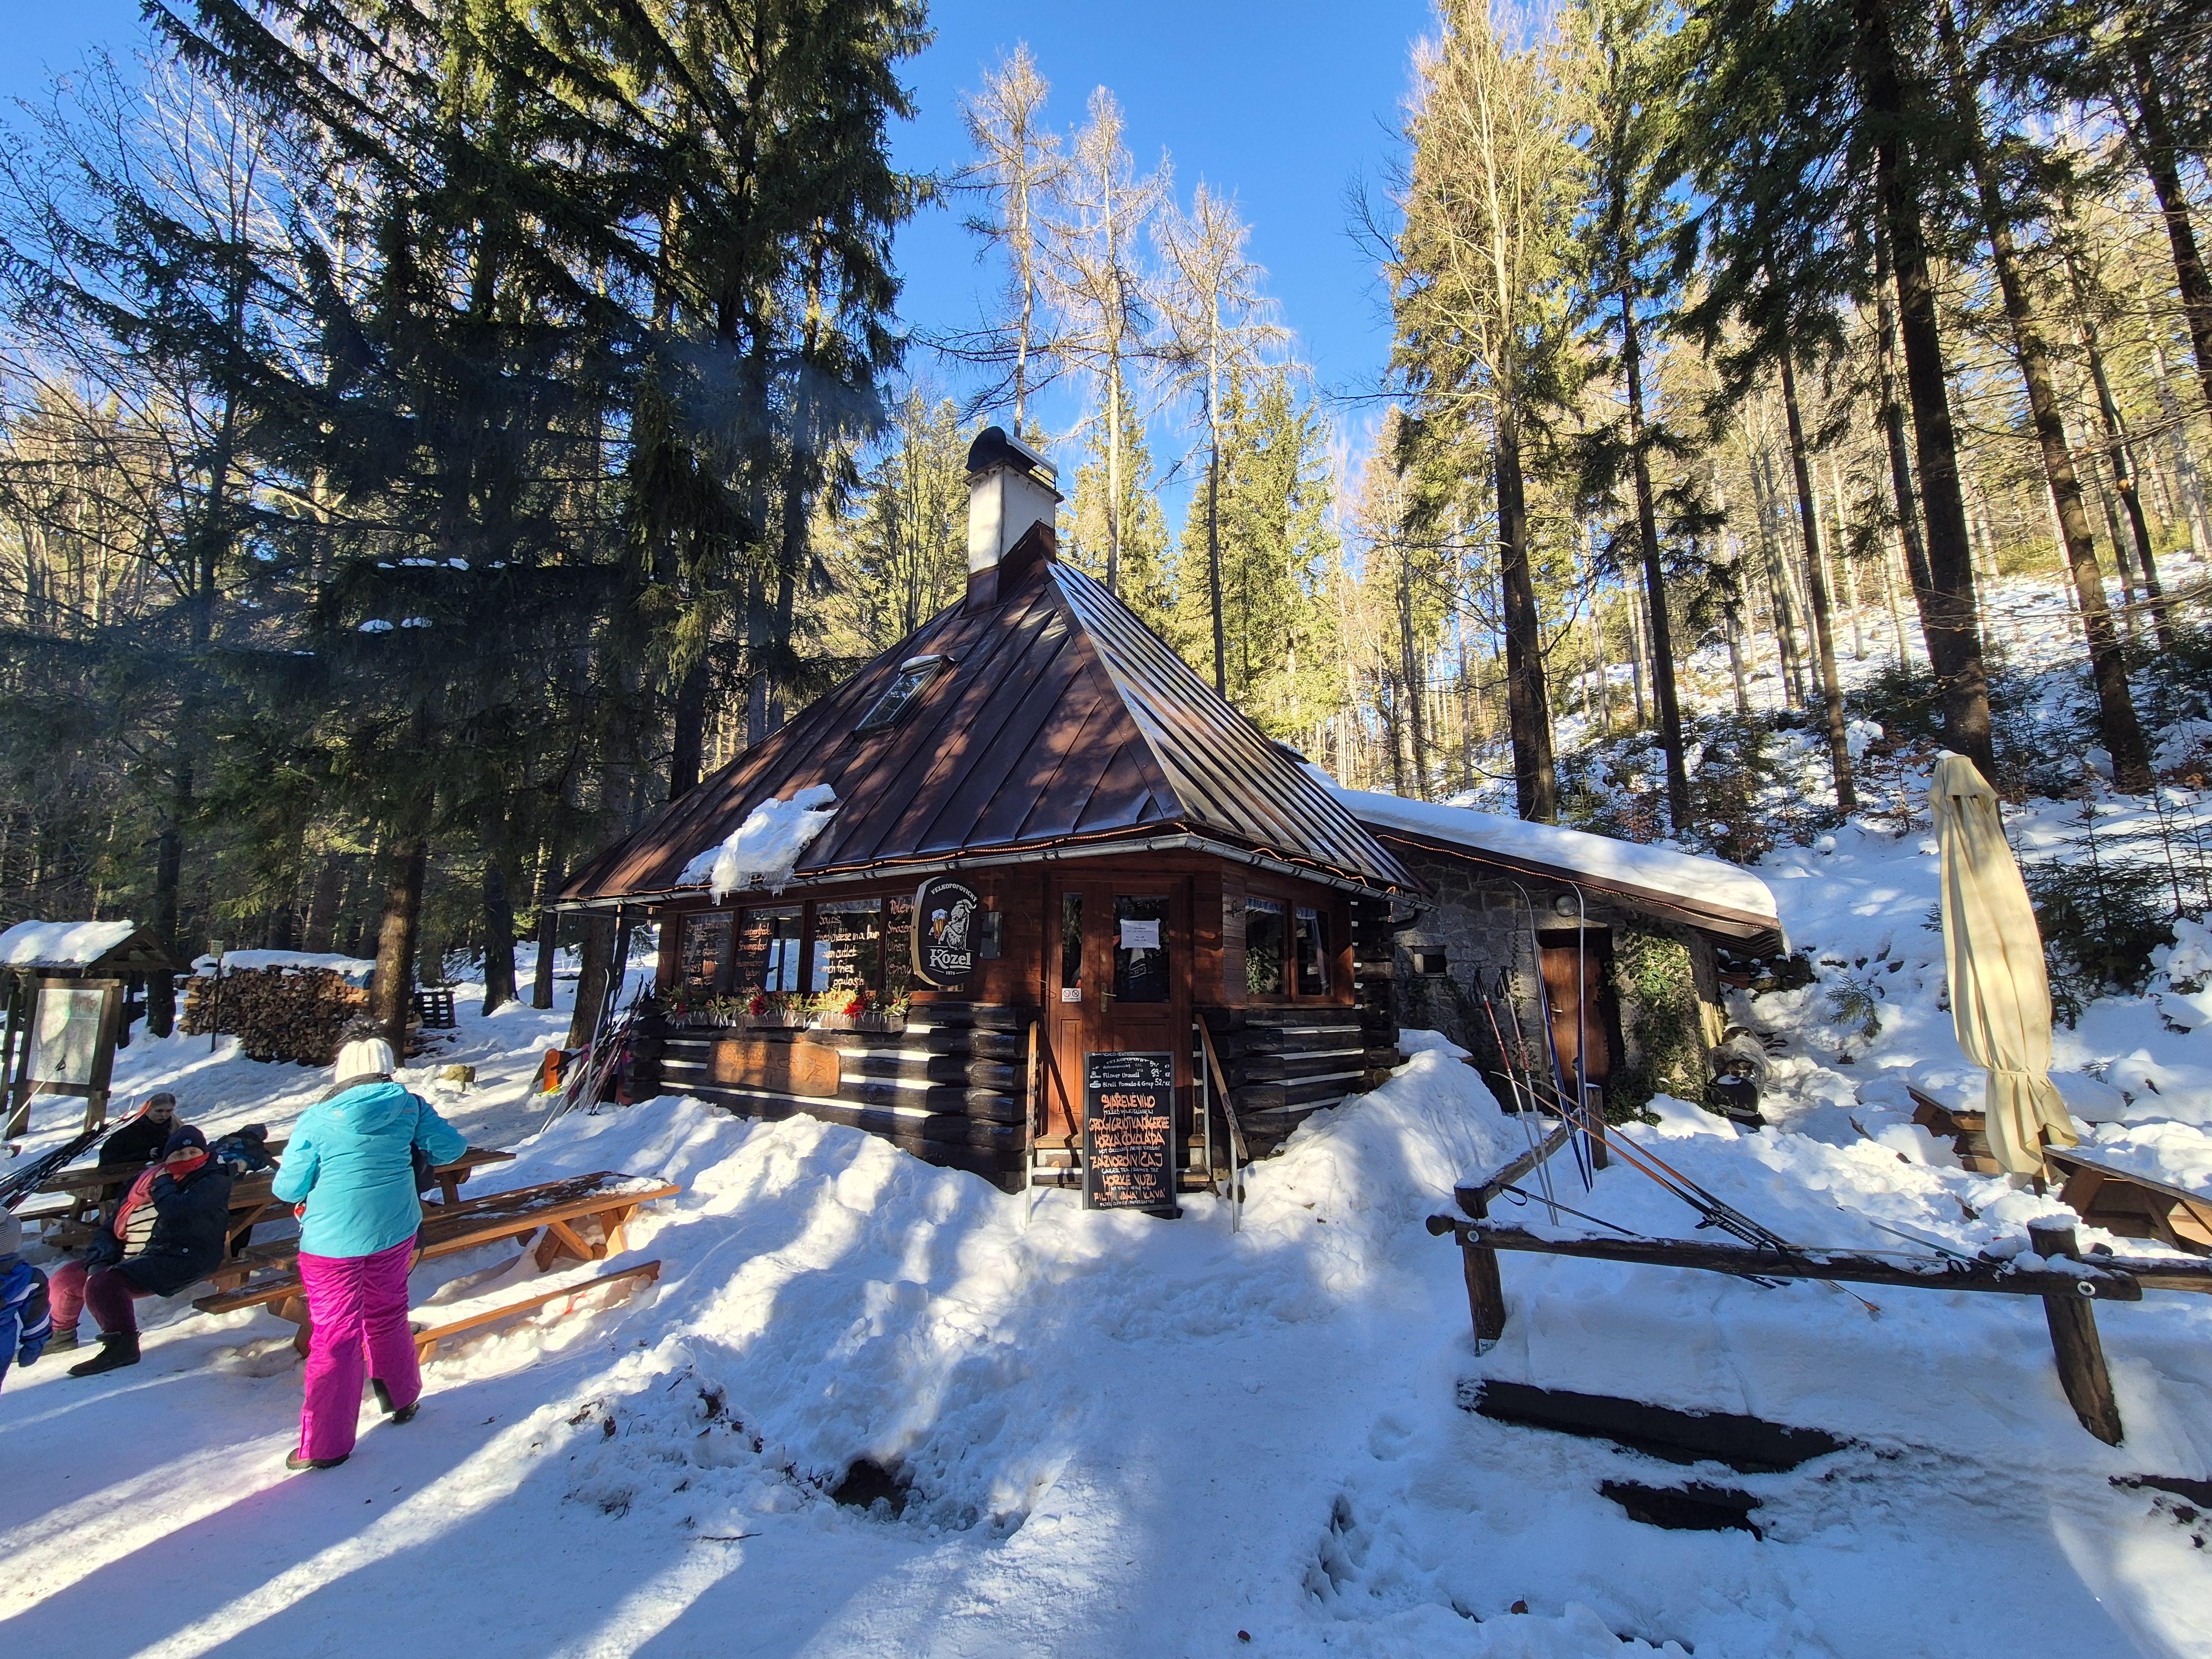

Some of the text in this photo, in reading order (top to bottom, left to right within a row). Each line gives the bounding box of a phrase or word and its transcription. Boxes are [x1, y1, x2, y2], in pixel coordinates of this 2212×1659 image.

[931, 883, 978, 902] VELKOPOPOVICKÝ
[858, 932, 865, 940] a
[836, 959, 854, 974] fries
[930, 948, 971, 969] Kozel
[1141, 1081, 1154, 1089] Grep
[1723, 1222, 1760, 1245] KARHU
